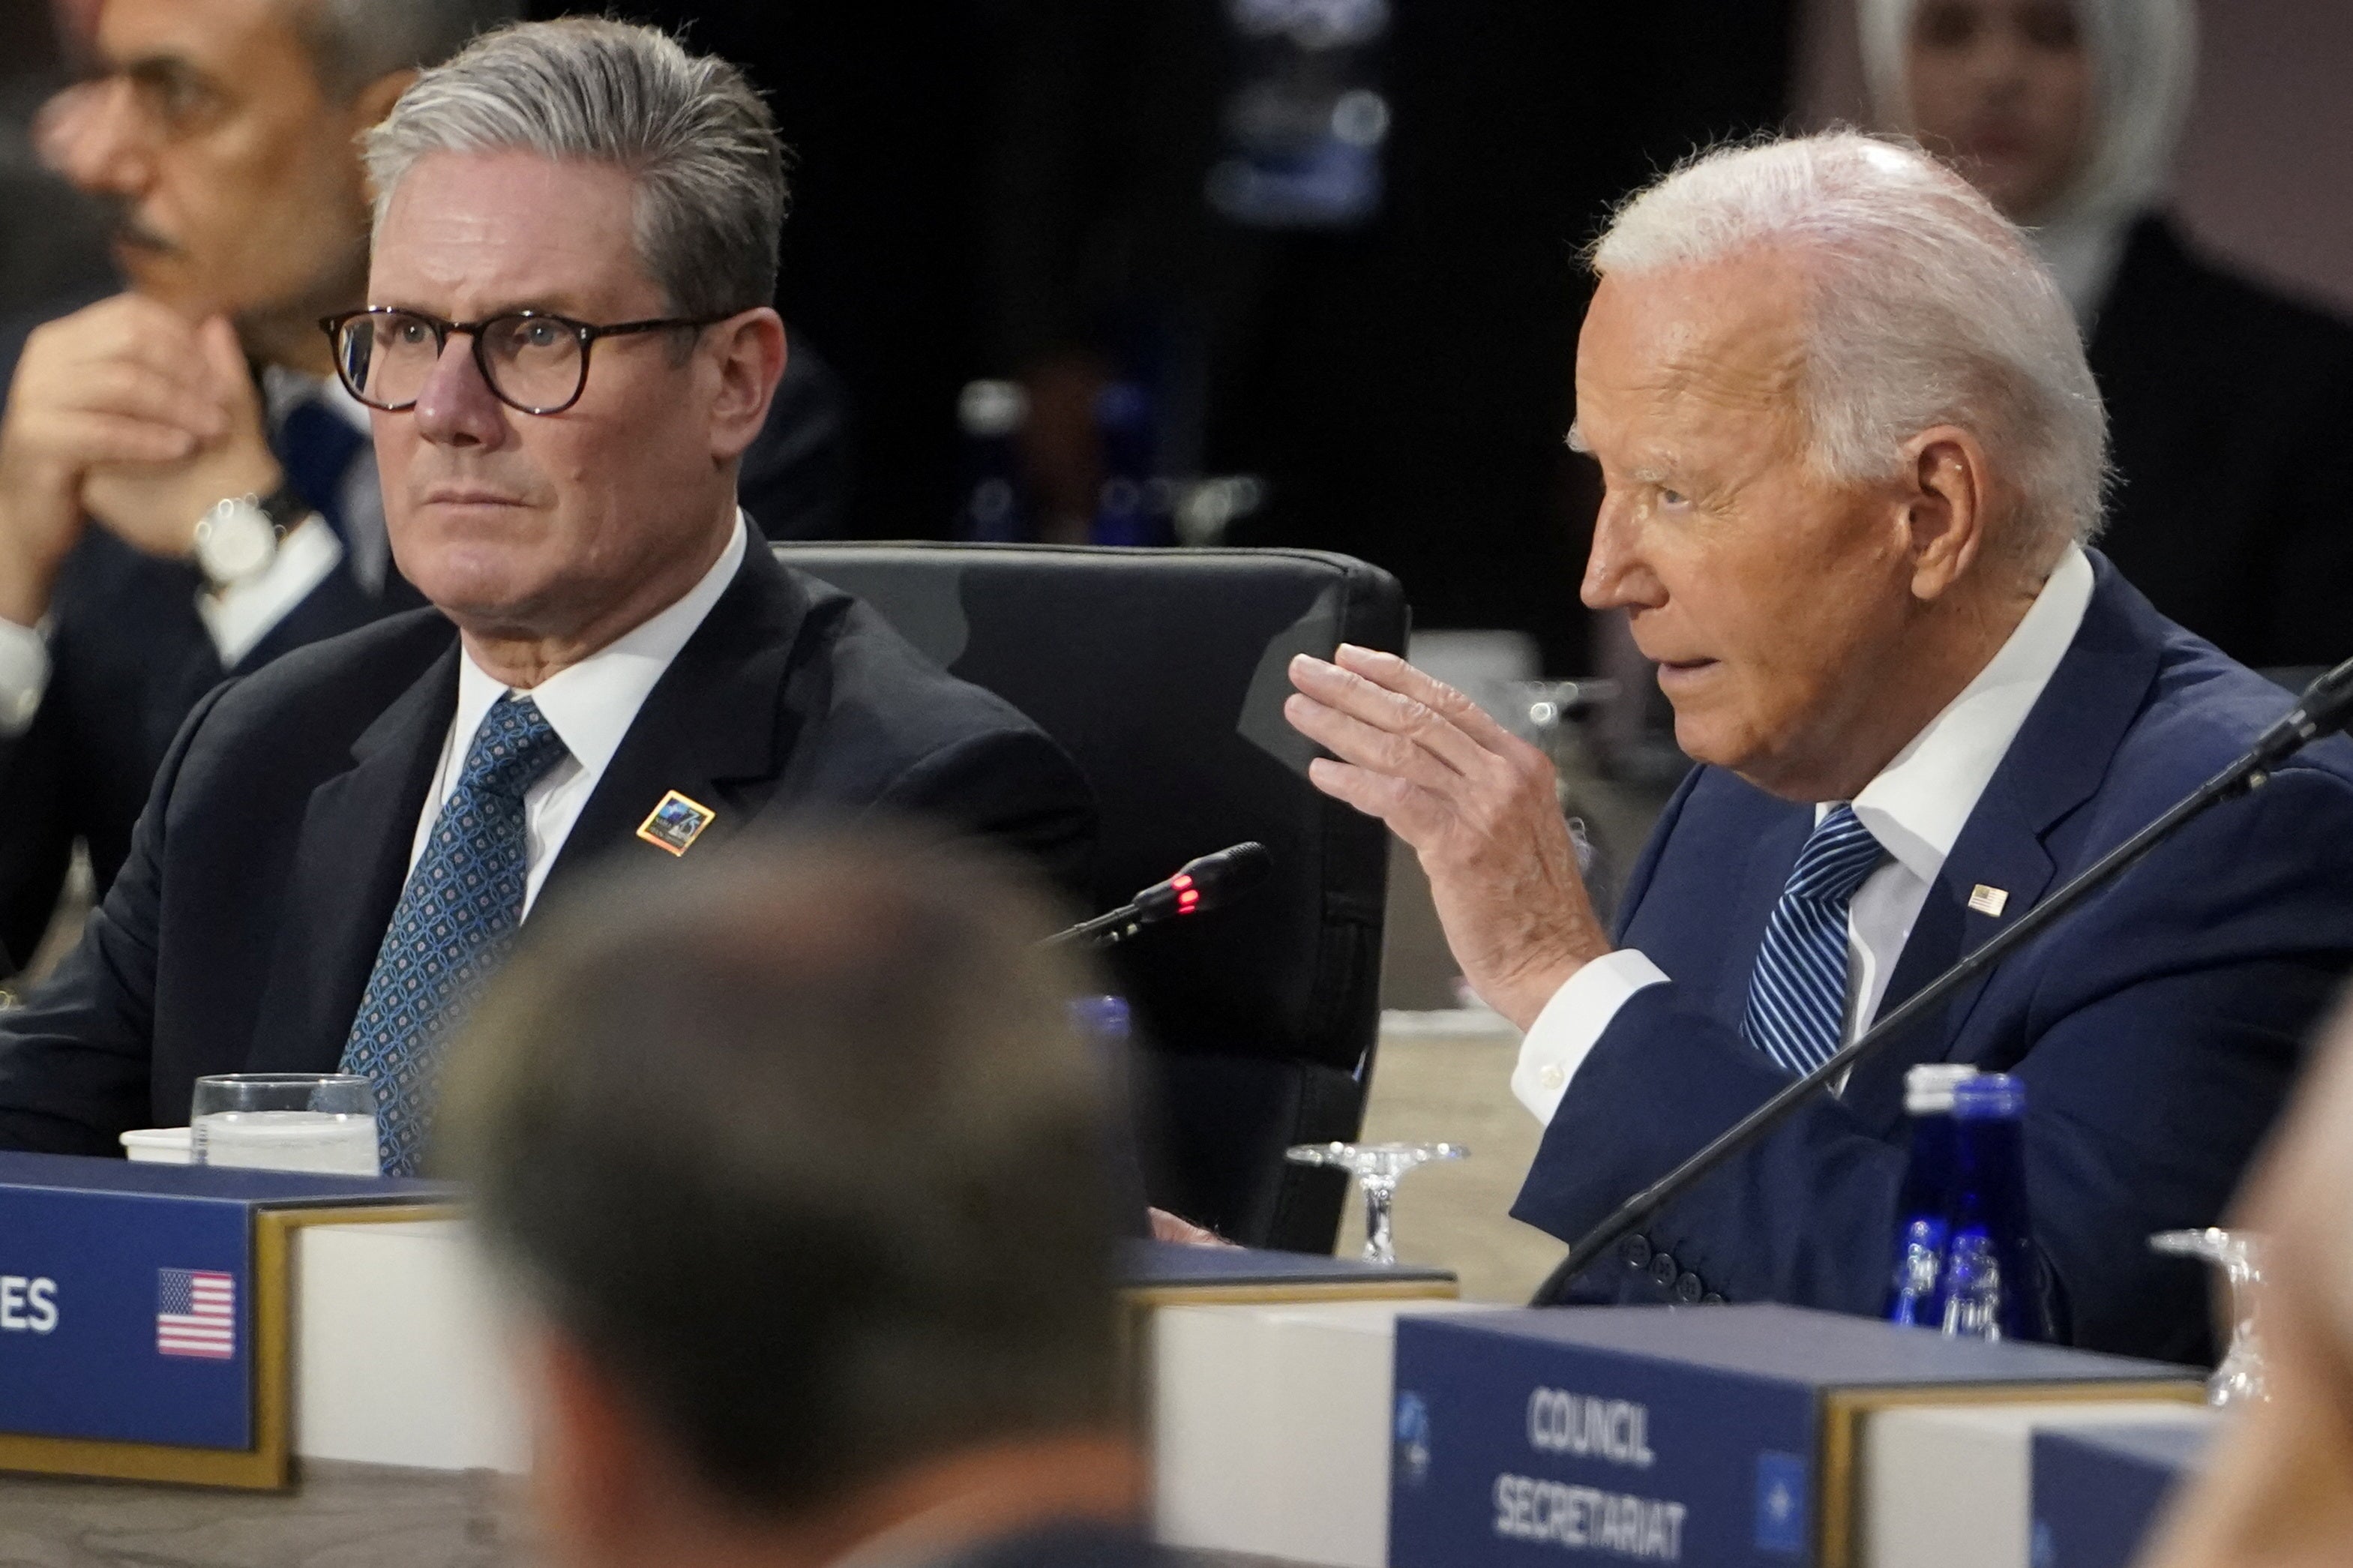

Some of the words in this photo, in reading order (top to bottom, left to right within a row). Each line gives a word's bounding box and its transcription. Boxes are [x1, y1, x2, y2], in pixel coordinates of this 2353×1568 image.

[0, 1276, 58, 1333] ES
[1527, 1387, 1656, 1465] COUNCIL
[1494, 1474, 1686, 1560] SECRETARIAT
